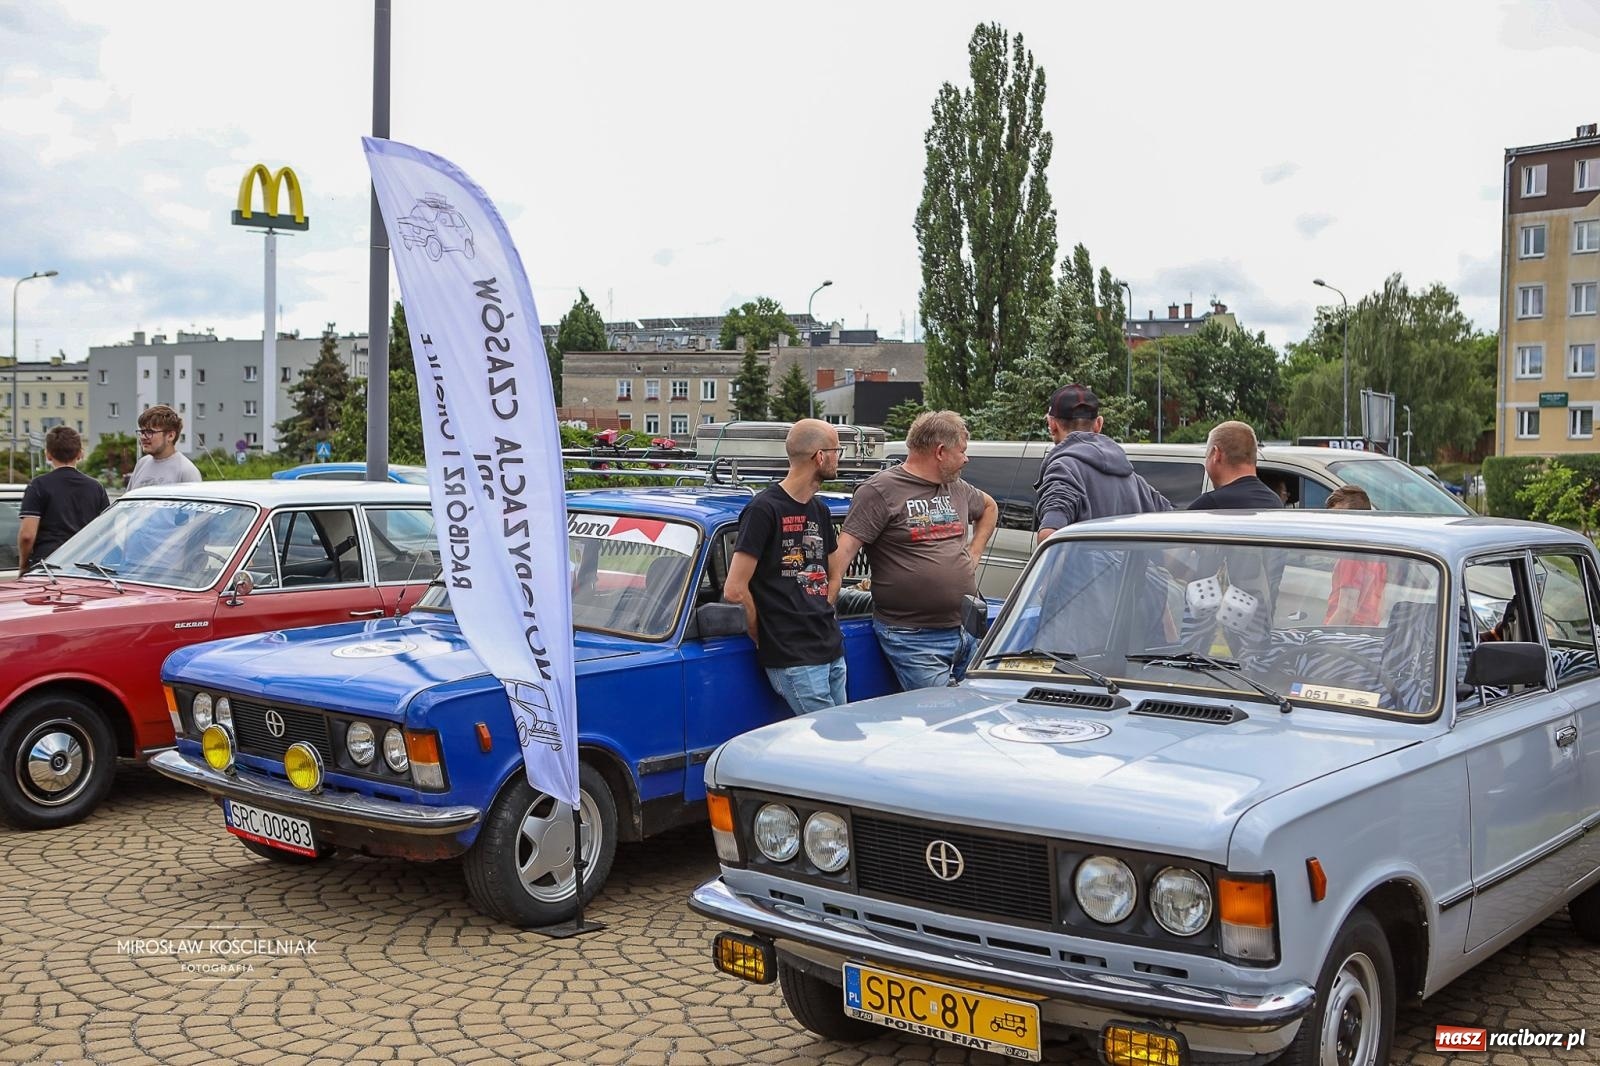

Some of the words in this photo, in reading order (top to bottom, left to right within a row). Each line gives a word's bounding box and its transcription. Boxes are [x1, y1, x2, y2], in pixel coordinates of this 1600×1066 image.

[567, 513, 610, 536] boro
[1305, 689, 1328, 701] 051
[231, 804, 260, 833] SRC
[262, 813, 312, 847] 00883
[849, 992, 860, 1004] PL
[866, 975, 928, 1022] SRC
[940, 993, 980, 1035] 8Y
[884, 1016, 945, 1040] POLSKI
[951, 1033, 992, 1051] FIAT
